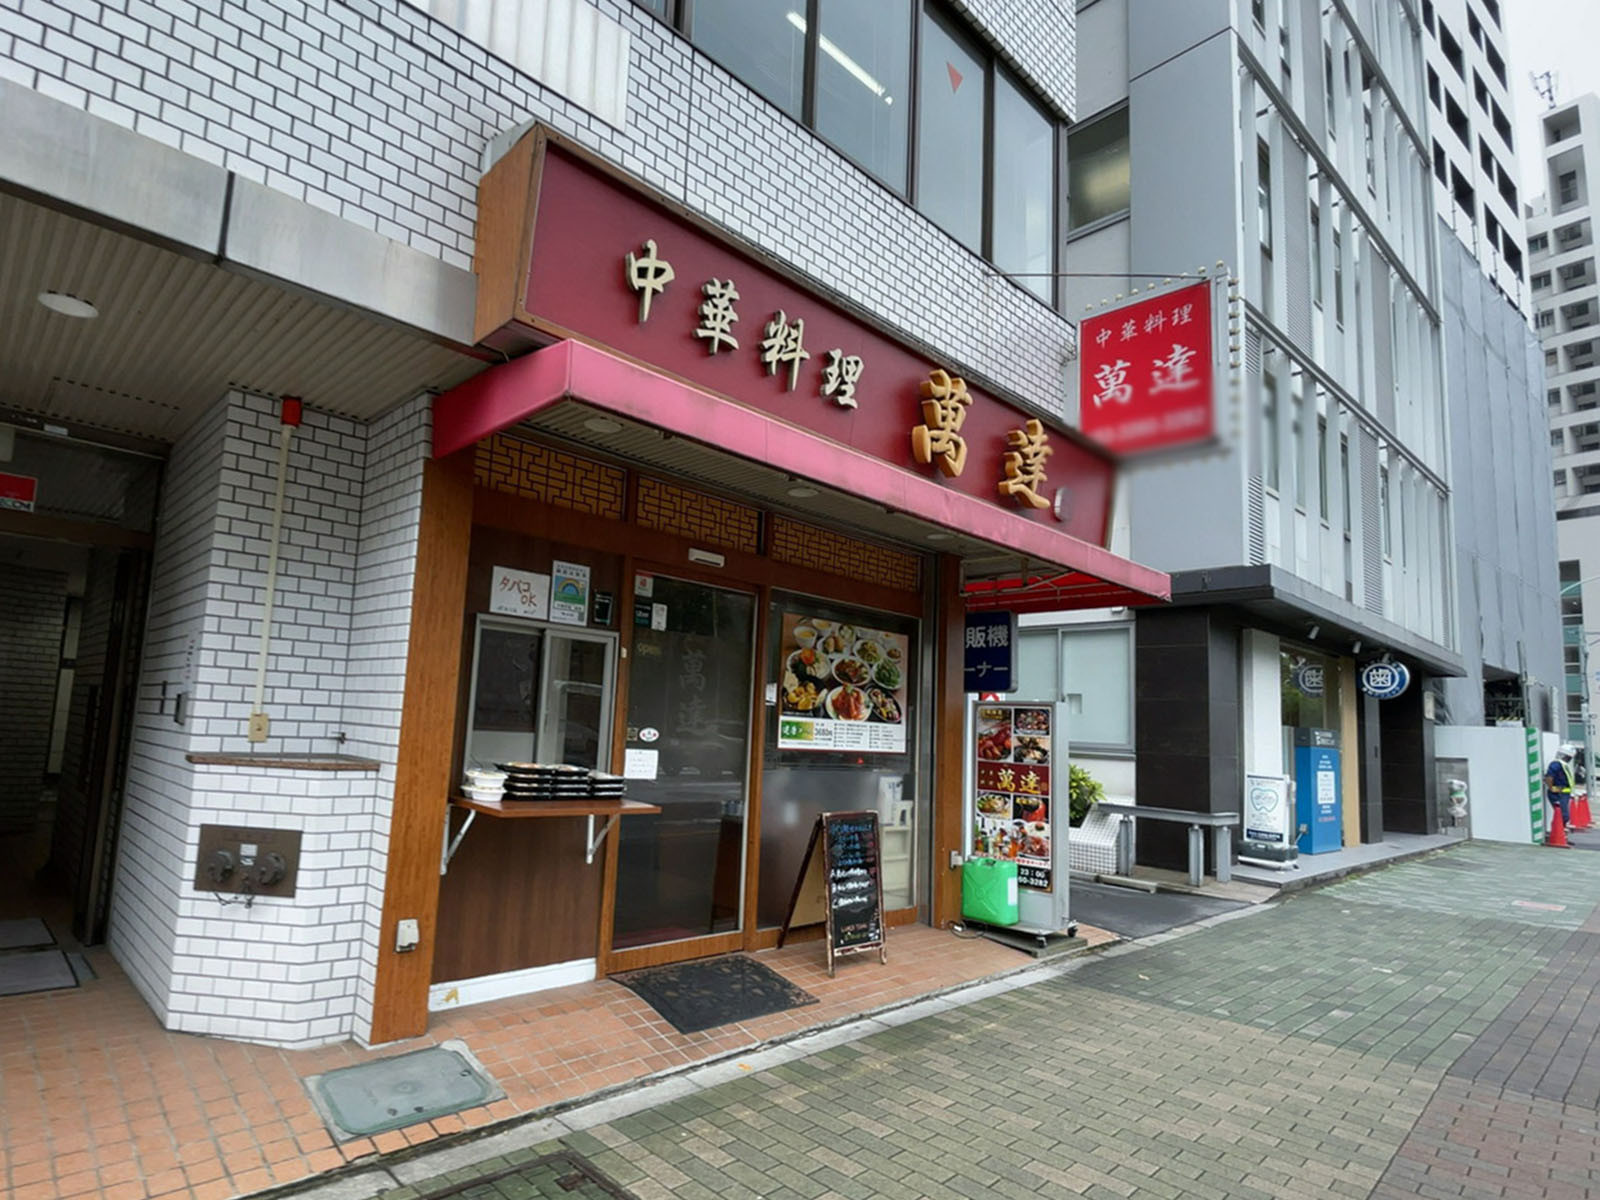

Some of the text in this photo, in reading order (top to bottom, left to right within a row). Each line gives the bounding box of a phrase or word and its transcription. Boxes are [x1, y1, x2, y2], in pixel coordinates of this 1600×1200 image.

[625, 239, 865, 410] 中華料理
[1095, 303, 1194, 349] 中華料理
[1092, 343, 1201, 408] 萬達
[520, 592, 538, 607] OK
[965, 624, 1009, 649] 販機
